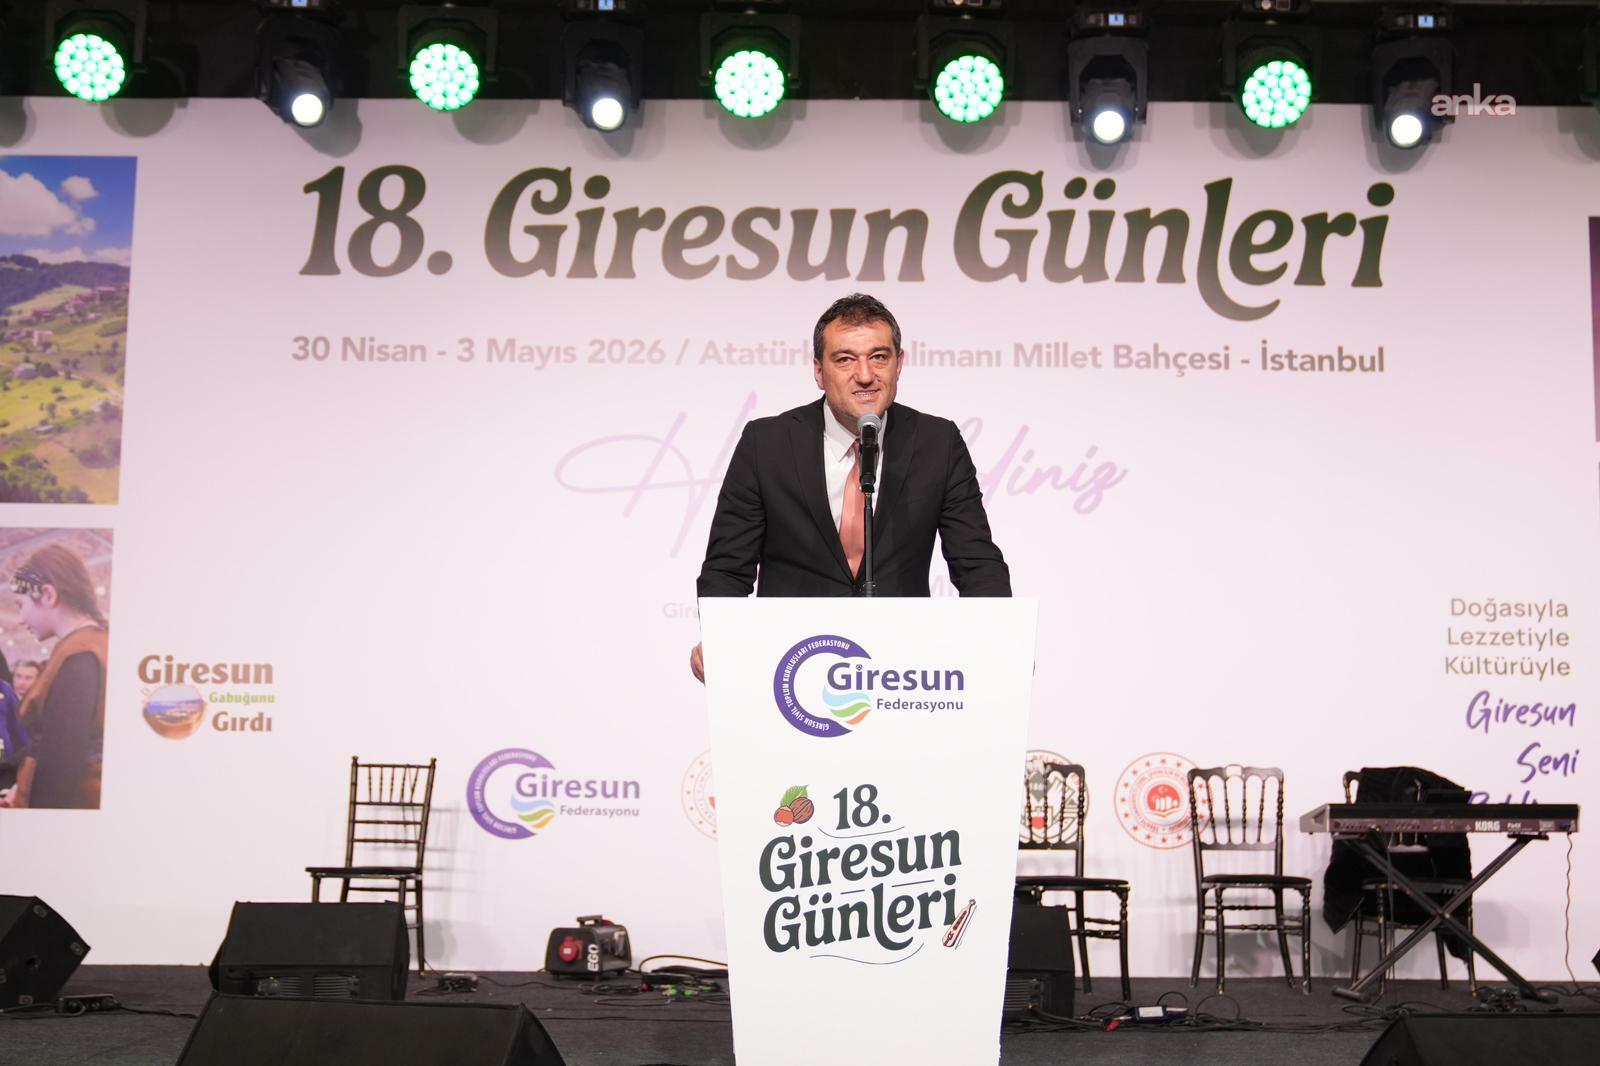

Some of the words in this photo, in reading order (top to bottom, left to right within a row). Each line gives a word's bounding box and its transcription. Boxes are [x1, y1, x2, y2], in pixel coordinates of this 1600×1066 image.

[298, 164, 453, 278] 18.
[484, 166, 929, 283] Giresun
[953, 169, 1395, 321] Günleri
[291, 336, 330, 361] 30
[341, 336, 427, 362] Nisan
[456, 338, 475, 363] 3
[486, 338, 577, 371] Mayıs
[588, 339, 666, 365] 2026
[675, 338, 690, 366] /
[699, 340, 814, 366] Atatürk
[1013, 342, 1103, 369] Millet
[1113, 343, 1230, 377] Bahçesi
[1261, 339, 1385, 372] İstanbul
[1450, 598, 1568, 622] Doğasıyla
[1447, 627, 1570, 652] Lezzetiyle
[138, 655, 273, 684] Giresun
[782, 683, 793, 707] TOPLUM
[807, 639, 850, 651] FEDERASYONU
[827, 662, 964, 690] Giresun
[1445, 656, 1571, 681] Kültürüyle
[209, 692, 275, 705] Gabuğunu
[876, 698, 964, 712] Federasyonu
[1466, 690, 1576, 734] Giresun
[212, 711, 273, 732] Gırdı
[1517, 742, 1579, 783] Seni
[516, 773, 641, 799] Giresun
[559, 805, 640, 818] Federasyonu
[833, 784, 892, 830] 18.
[1475, 821, 1501, 831] KORG
[759, 830, 962, 892] Giresun
[763, 873, 957, 953] Günleri
[587, 944, 599, 972] EGO
